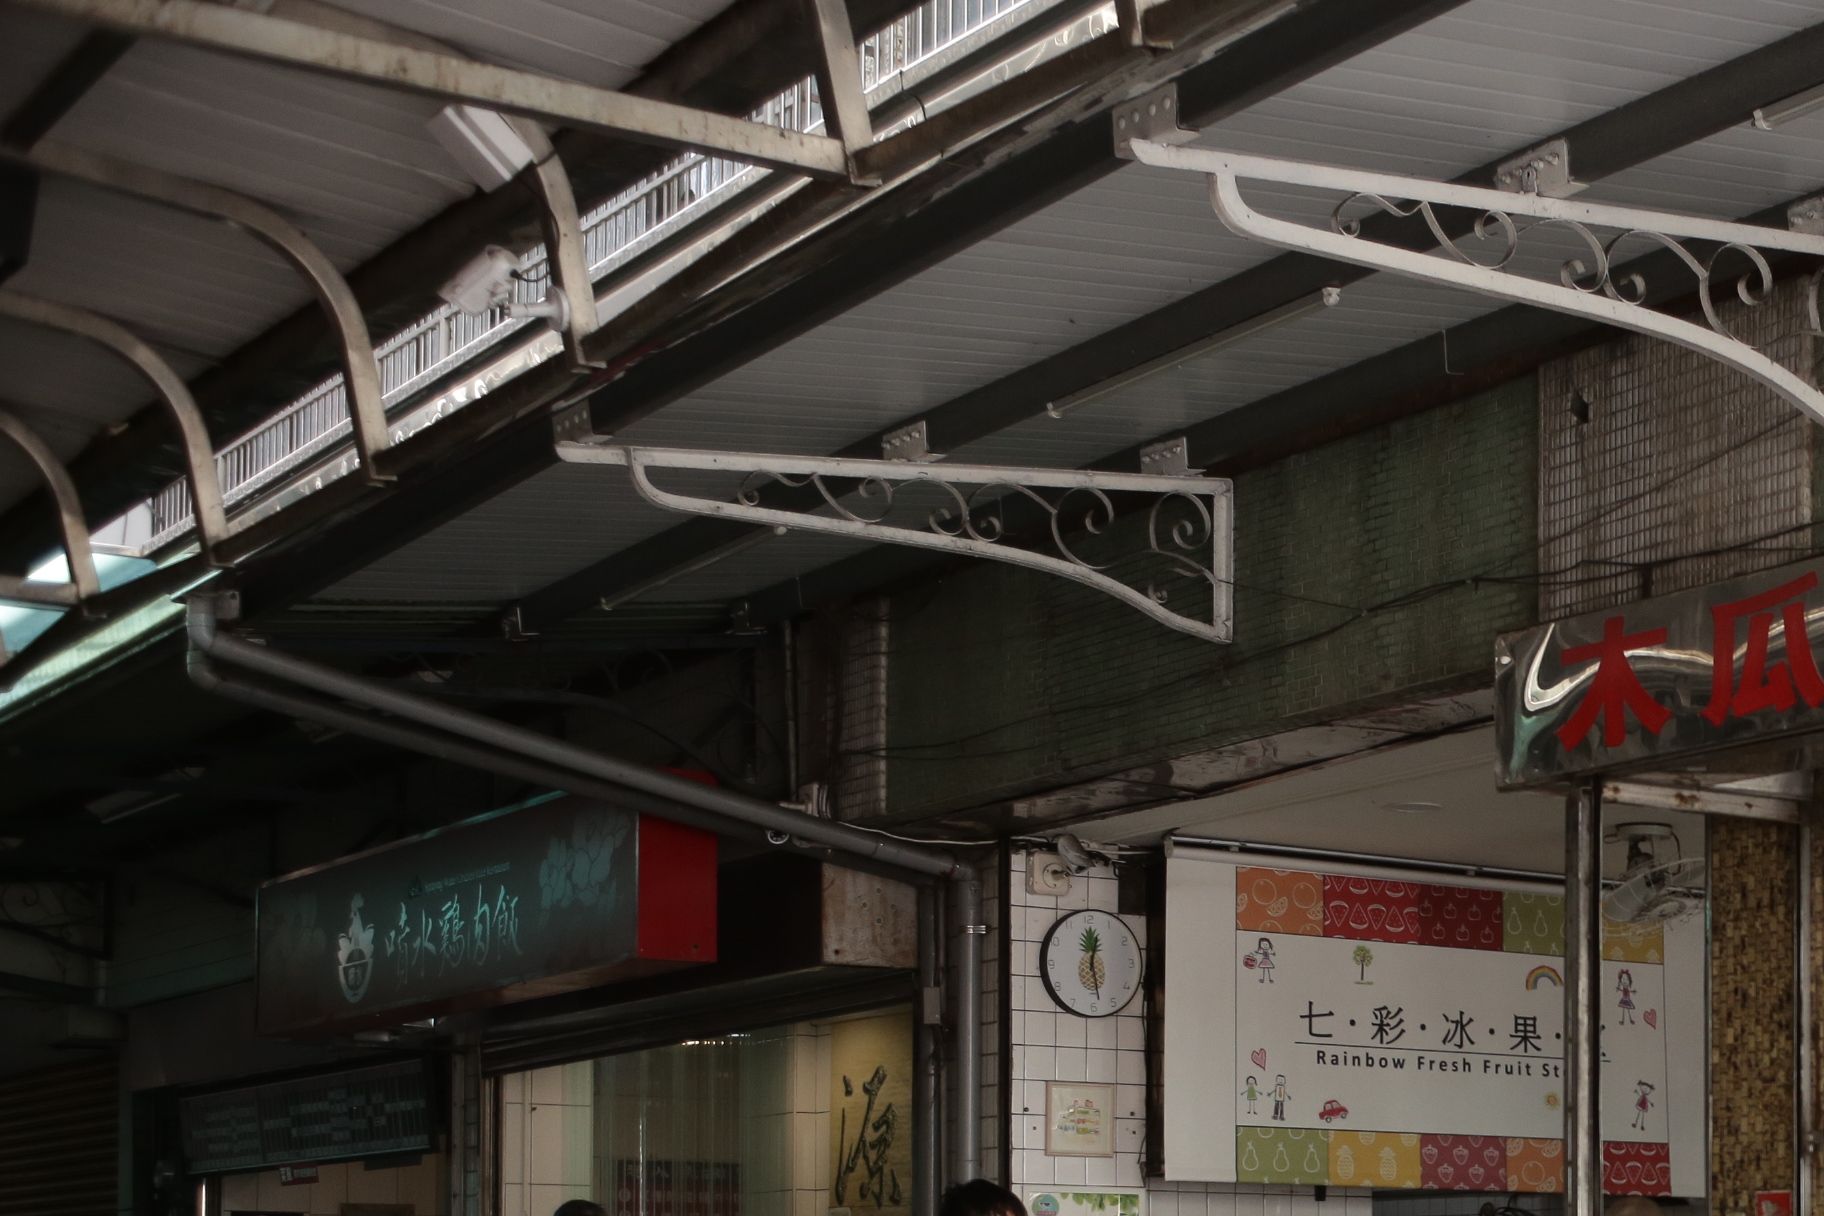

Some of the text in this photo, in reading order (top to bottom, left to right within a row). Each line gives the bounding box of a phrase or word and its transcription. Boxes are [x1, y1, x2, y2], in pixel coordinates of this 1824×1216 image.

[1316, 1050, 1405, 1069] Rainbow
[1417, 1056, 1471, 1073] Fresh
[1483, 1060, 1531, 1076] Fruit
